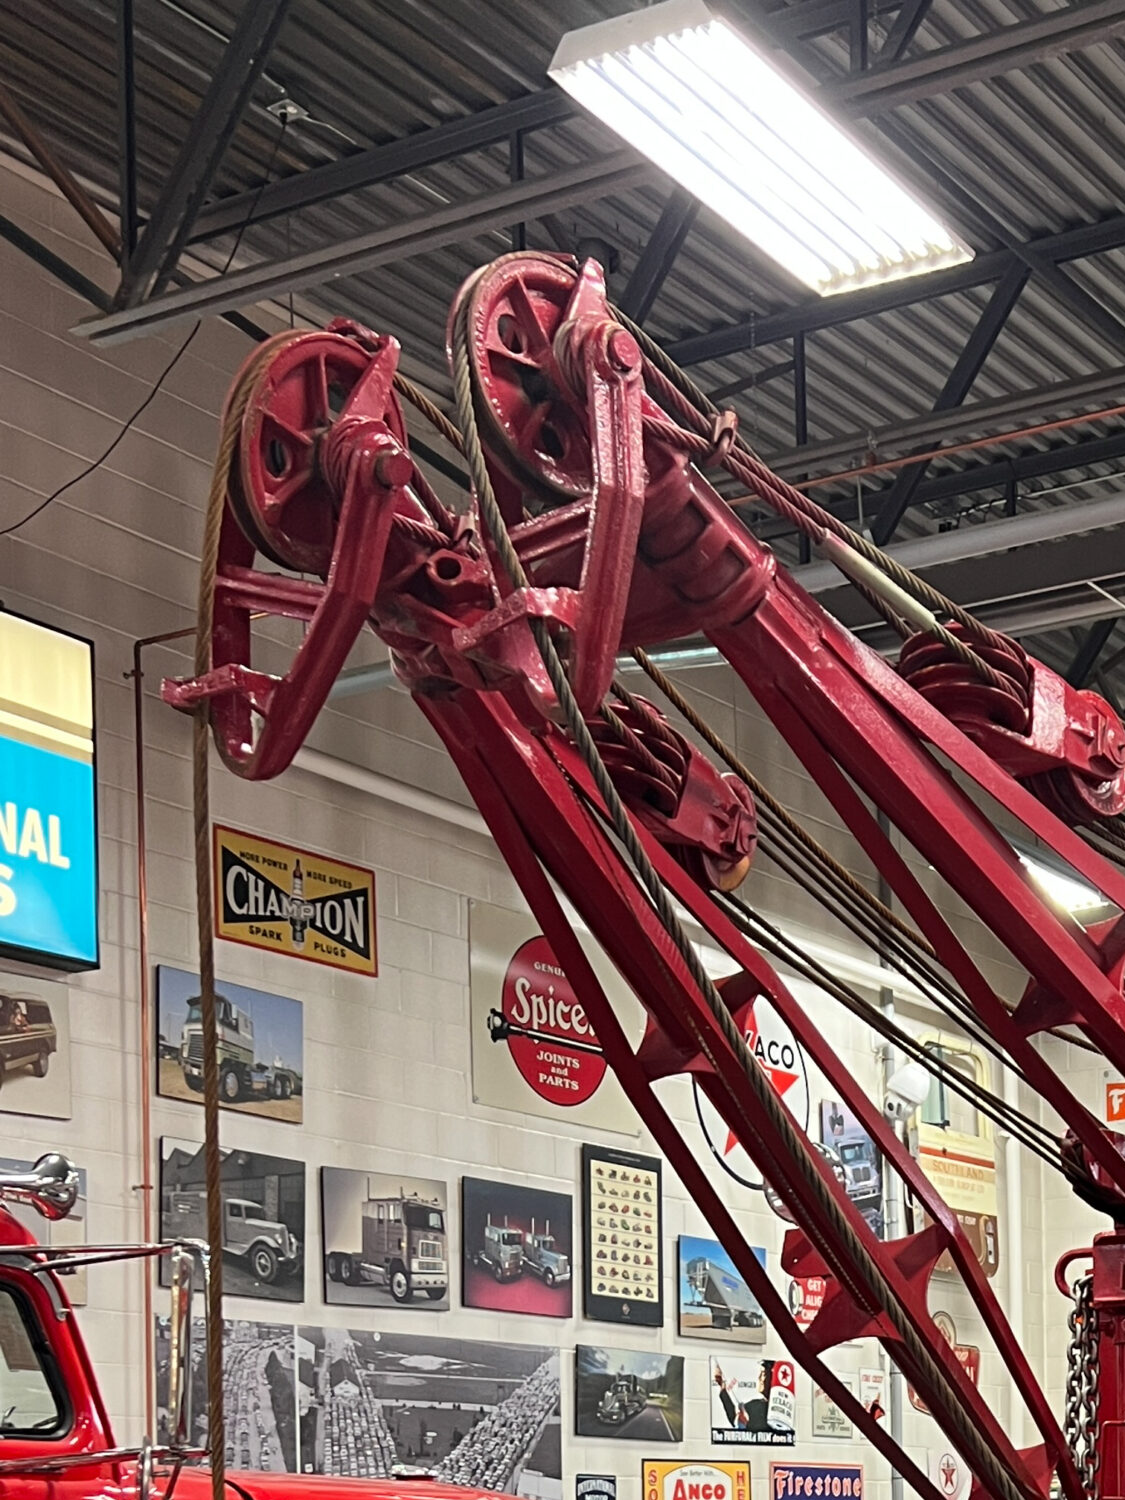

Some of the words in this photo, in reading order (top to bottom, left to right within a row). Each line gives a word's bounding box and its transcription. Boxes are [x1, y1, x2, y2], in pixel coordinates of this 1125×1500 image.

[239, 850, 259, 864] MORE
[262, 857, 288, 871] POWER
[306, 870, 326, 883] MORE
[329, 876, 352, 889] SPEED
[225, 864, 365, 949] CHAMPION
[248, 924, 283, 942] SPARK
[314, 941, 346, 958] PLUGS
[510, 977, 596, 1044] Spice
[536, 1050, 580, 1069] JOINTS
[551, 1065, 568, 1077] and
[538, 1072, 580, 1091] PARTS
[774, 1469, 861, 1499] Firestone
